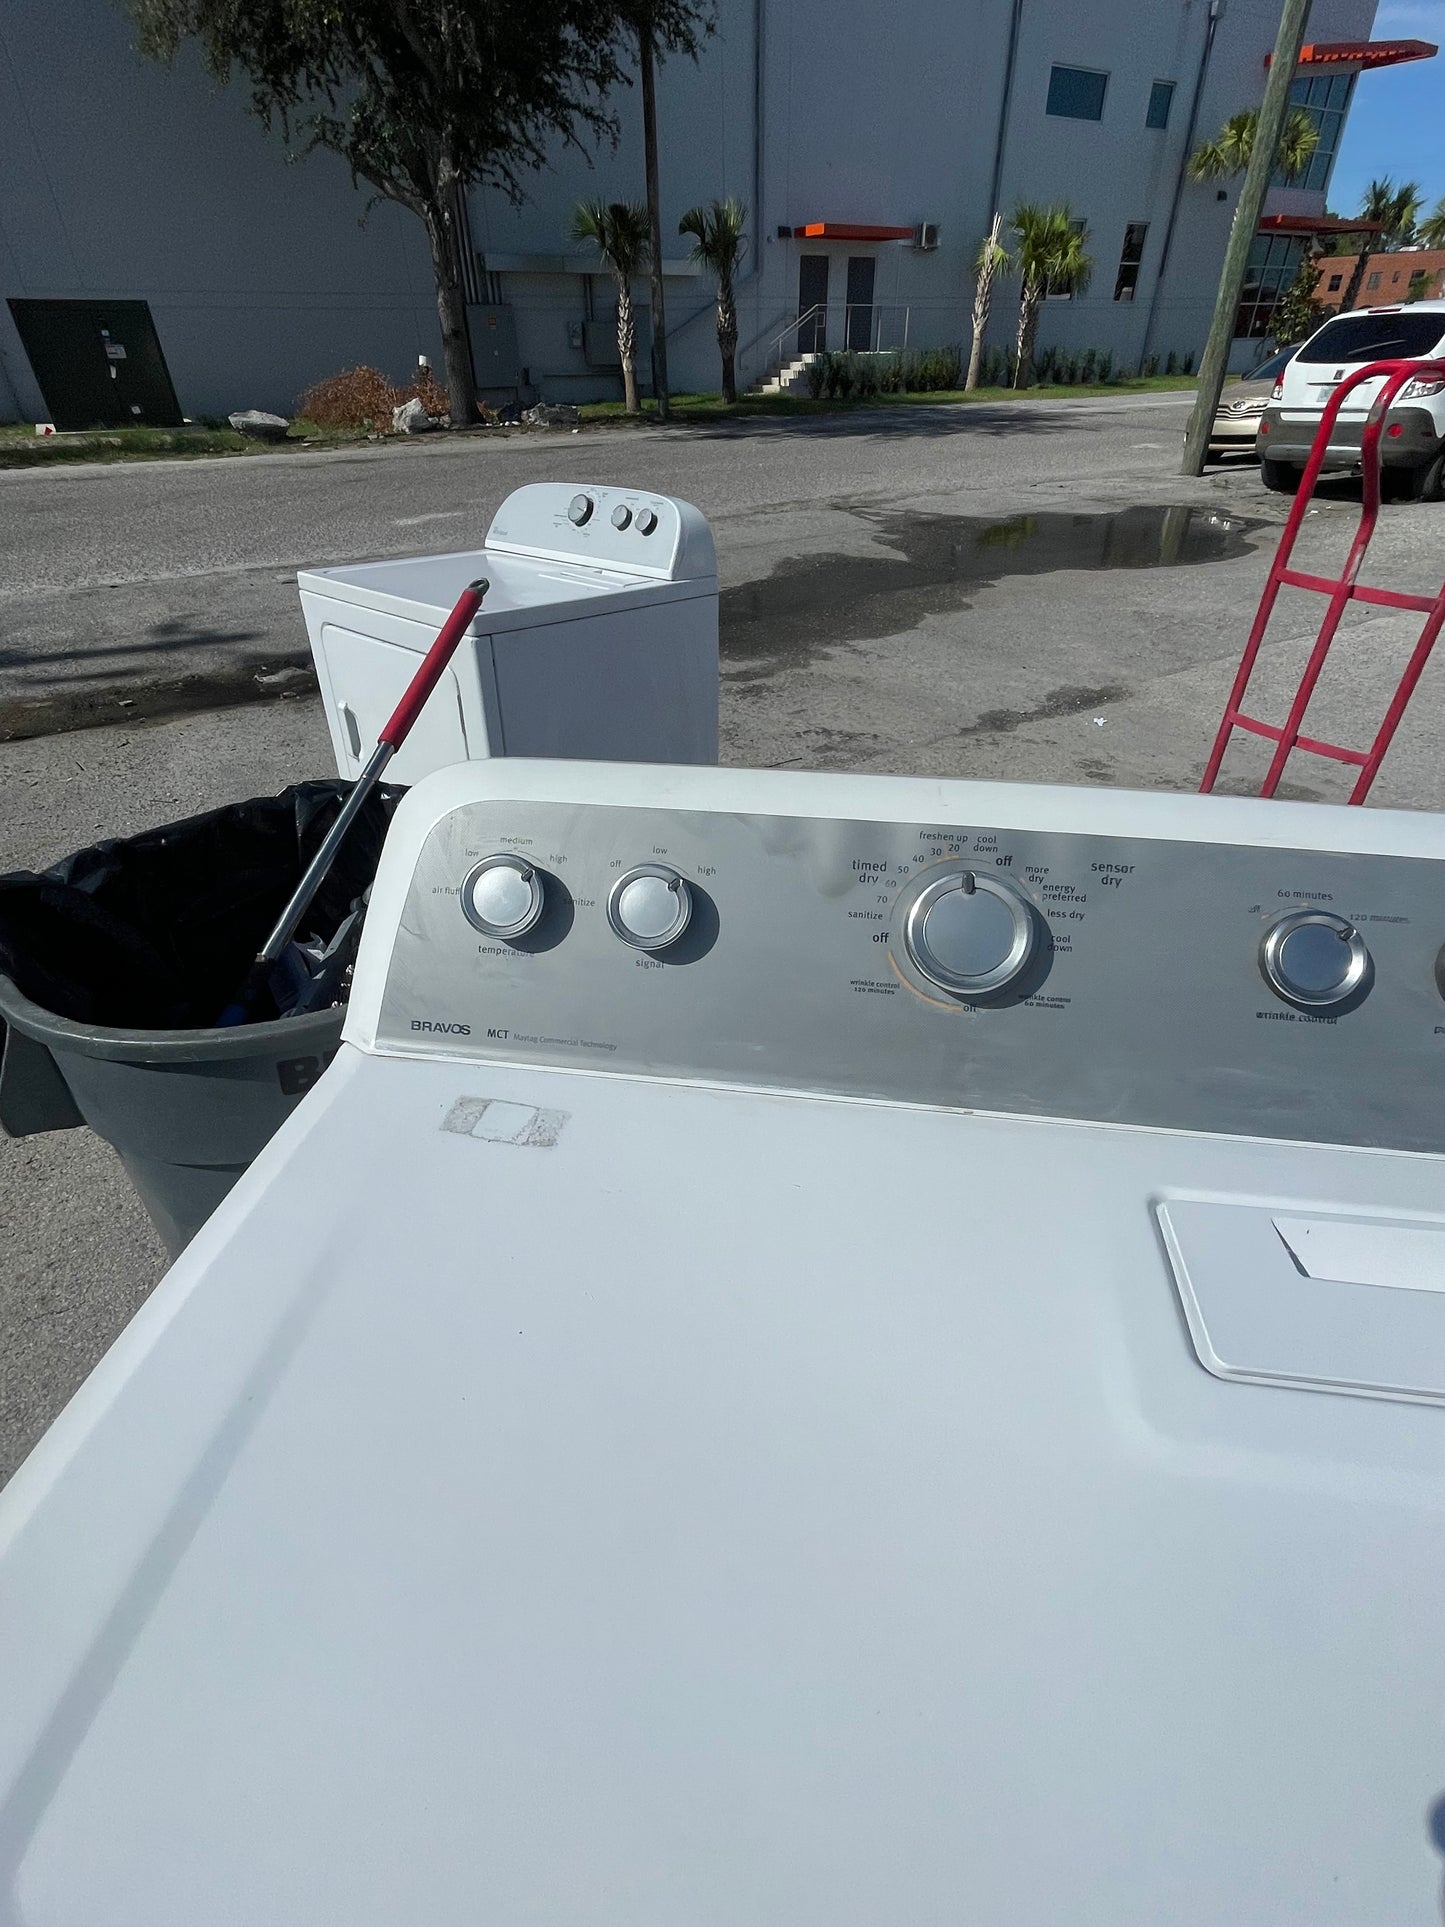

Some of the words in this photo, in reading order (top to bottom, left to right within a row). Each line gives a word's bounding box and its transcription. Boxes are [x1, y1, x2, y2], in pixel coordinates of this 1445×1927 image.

[500, 836, 533, 846] medium
[919, 831, 954, 841] freshen
[956, 833, 968, 842] up
[977, 835, 997, 844] cool
[464, 848, 479, 857] low
[652, 845, 668, 855] low
[930, 847, 942, 856] 30
[948, 844, 960, 852] 20
[973, 843, 998, 853] down
[550, 854, 568, 865] high
[609, 860, 621, 868] off
[912, 855, 925, 863] 40
[996, 855, 1013, 867] off
[852, 859, 887, 872] timed
[898, 865, 909, 874] 50
[1025, 865, 1050, 875] more
[1091, 862, 1136, 874] sensor
[697, 866, 716, 877] high
[858, 872, 879, 887] dry
[884, 879, 897, 888] 60
[1028, 874, 1045, 885] dry
[1101, 874, 1122, 888] dry
[431, 885, 442, 894] air
[1042, 884, 1076, 895] energy
[877, 895, 888, 904] 70
[1042, 893, 1087, 903] preferred
[1277, 889, 1290, 898] 60
[1293, 889, 1334, 901] minutes
[848, 910, 883, 920] sanitize
[1047, 908, 1067, 918] less
[1069, 910, 1085, 921] dry
[1350, 913, 1367, 922] 120
[872, 932, 889, 943] off
[1051, 935, 1071, 943] cool
[478, 945, 535, 957] temperature
[1047, 943, 1073, 953] down
[635, 958, 665, 970] signal
[850, 979, 875, 988] wrinkle
[876, 981, 900, 989] control
[868, 987, 895, 995] minutes
[1256, 1010, 1296, 1022] wrinkle
[411, 1020, 471, 1035] BRAVOS
[487, 1028, 509, 1039] MCT
[513, 1033, 539, 1044] Maytag
[539, 1036, 579, 1047] Commercial
[580, 1039, 618, 1051] Technology
